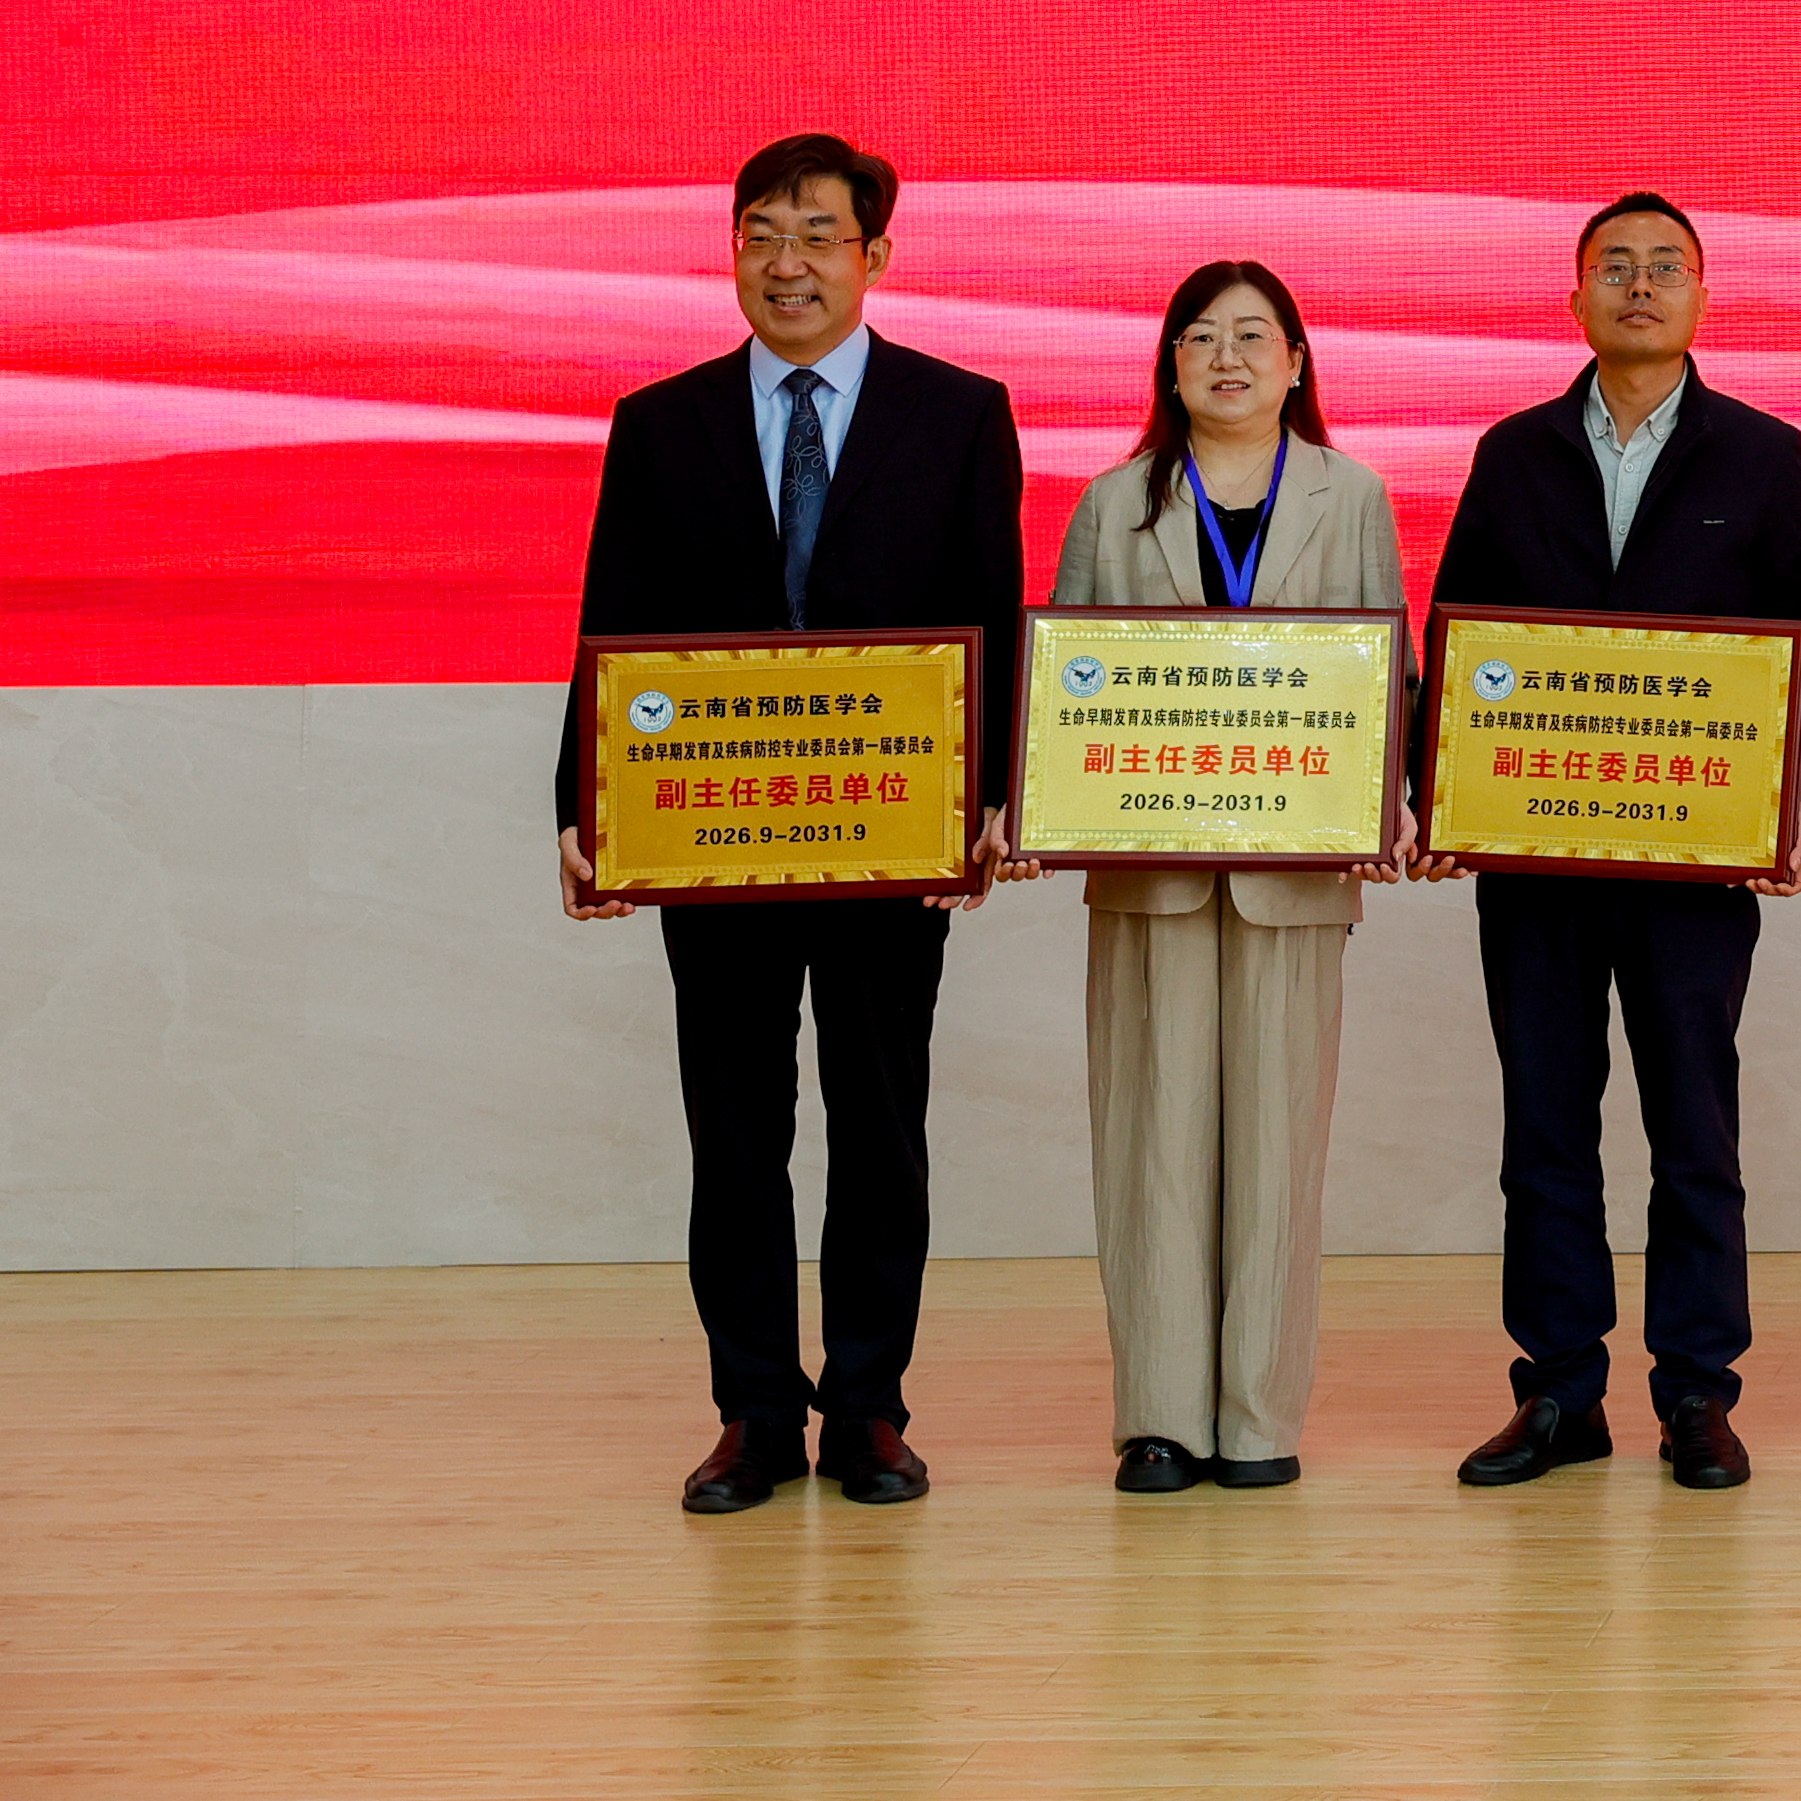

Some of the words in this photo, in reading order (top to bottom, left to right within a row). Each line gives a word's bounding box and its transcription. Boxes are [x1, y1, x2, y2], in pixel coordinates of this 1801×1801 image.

[1111, 665, 1308, 688] 云南省预防医学会
[1521, 670, 1712, 698] 云南省预防医学会
[679, 693, 883, 719] 云南省预防医学会
[1058, 707, 1356, 729] 生命早期发育及疾病防控专业委员会第一届委员会
[1469, 709, 1758, 741] 生命早期发育及疾病防控专业委员会第一届委员会
[627, 735, 934, 762] 生命早期发育及疾病防控专业委员会第一届委员会
[1084, 743, 1330, 777] 副主任委员单位
[1493, 747, 1731, 788] 副主任委员单位
[655, 772, 909, 811] 副主任委员单位
[1120, 793, 1286, 812] 2026.9-2031.9
[1527, 798, 1688, 822] 2026.9-2031.9
[694, 823, 866, 846] 2026.9-2031.9
